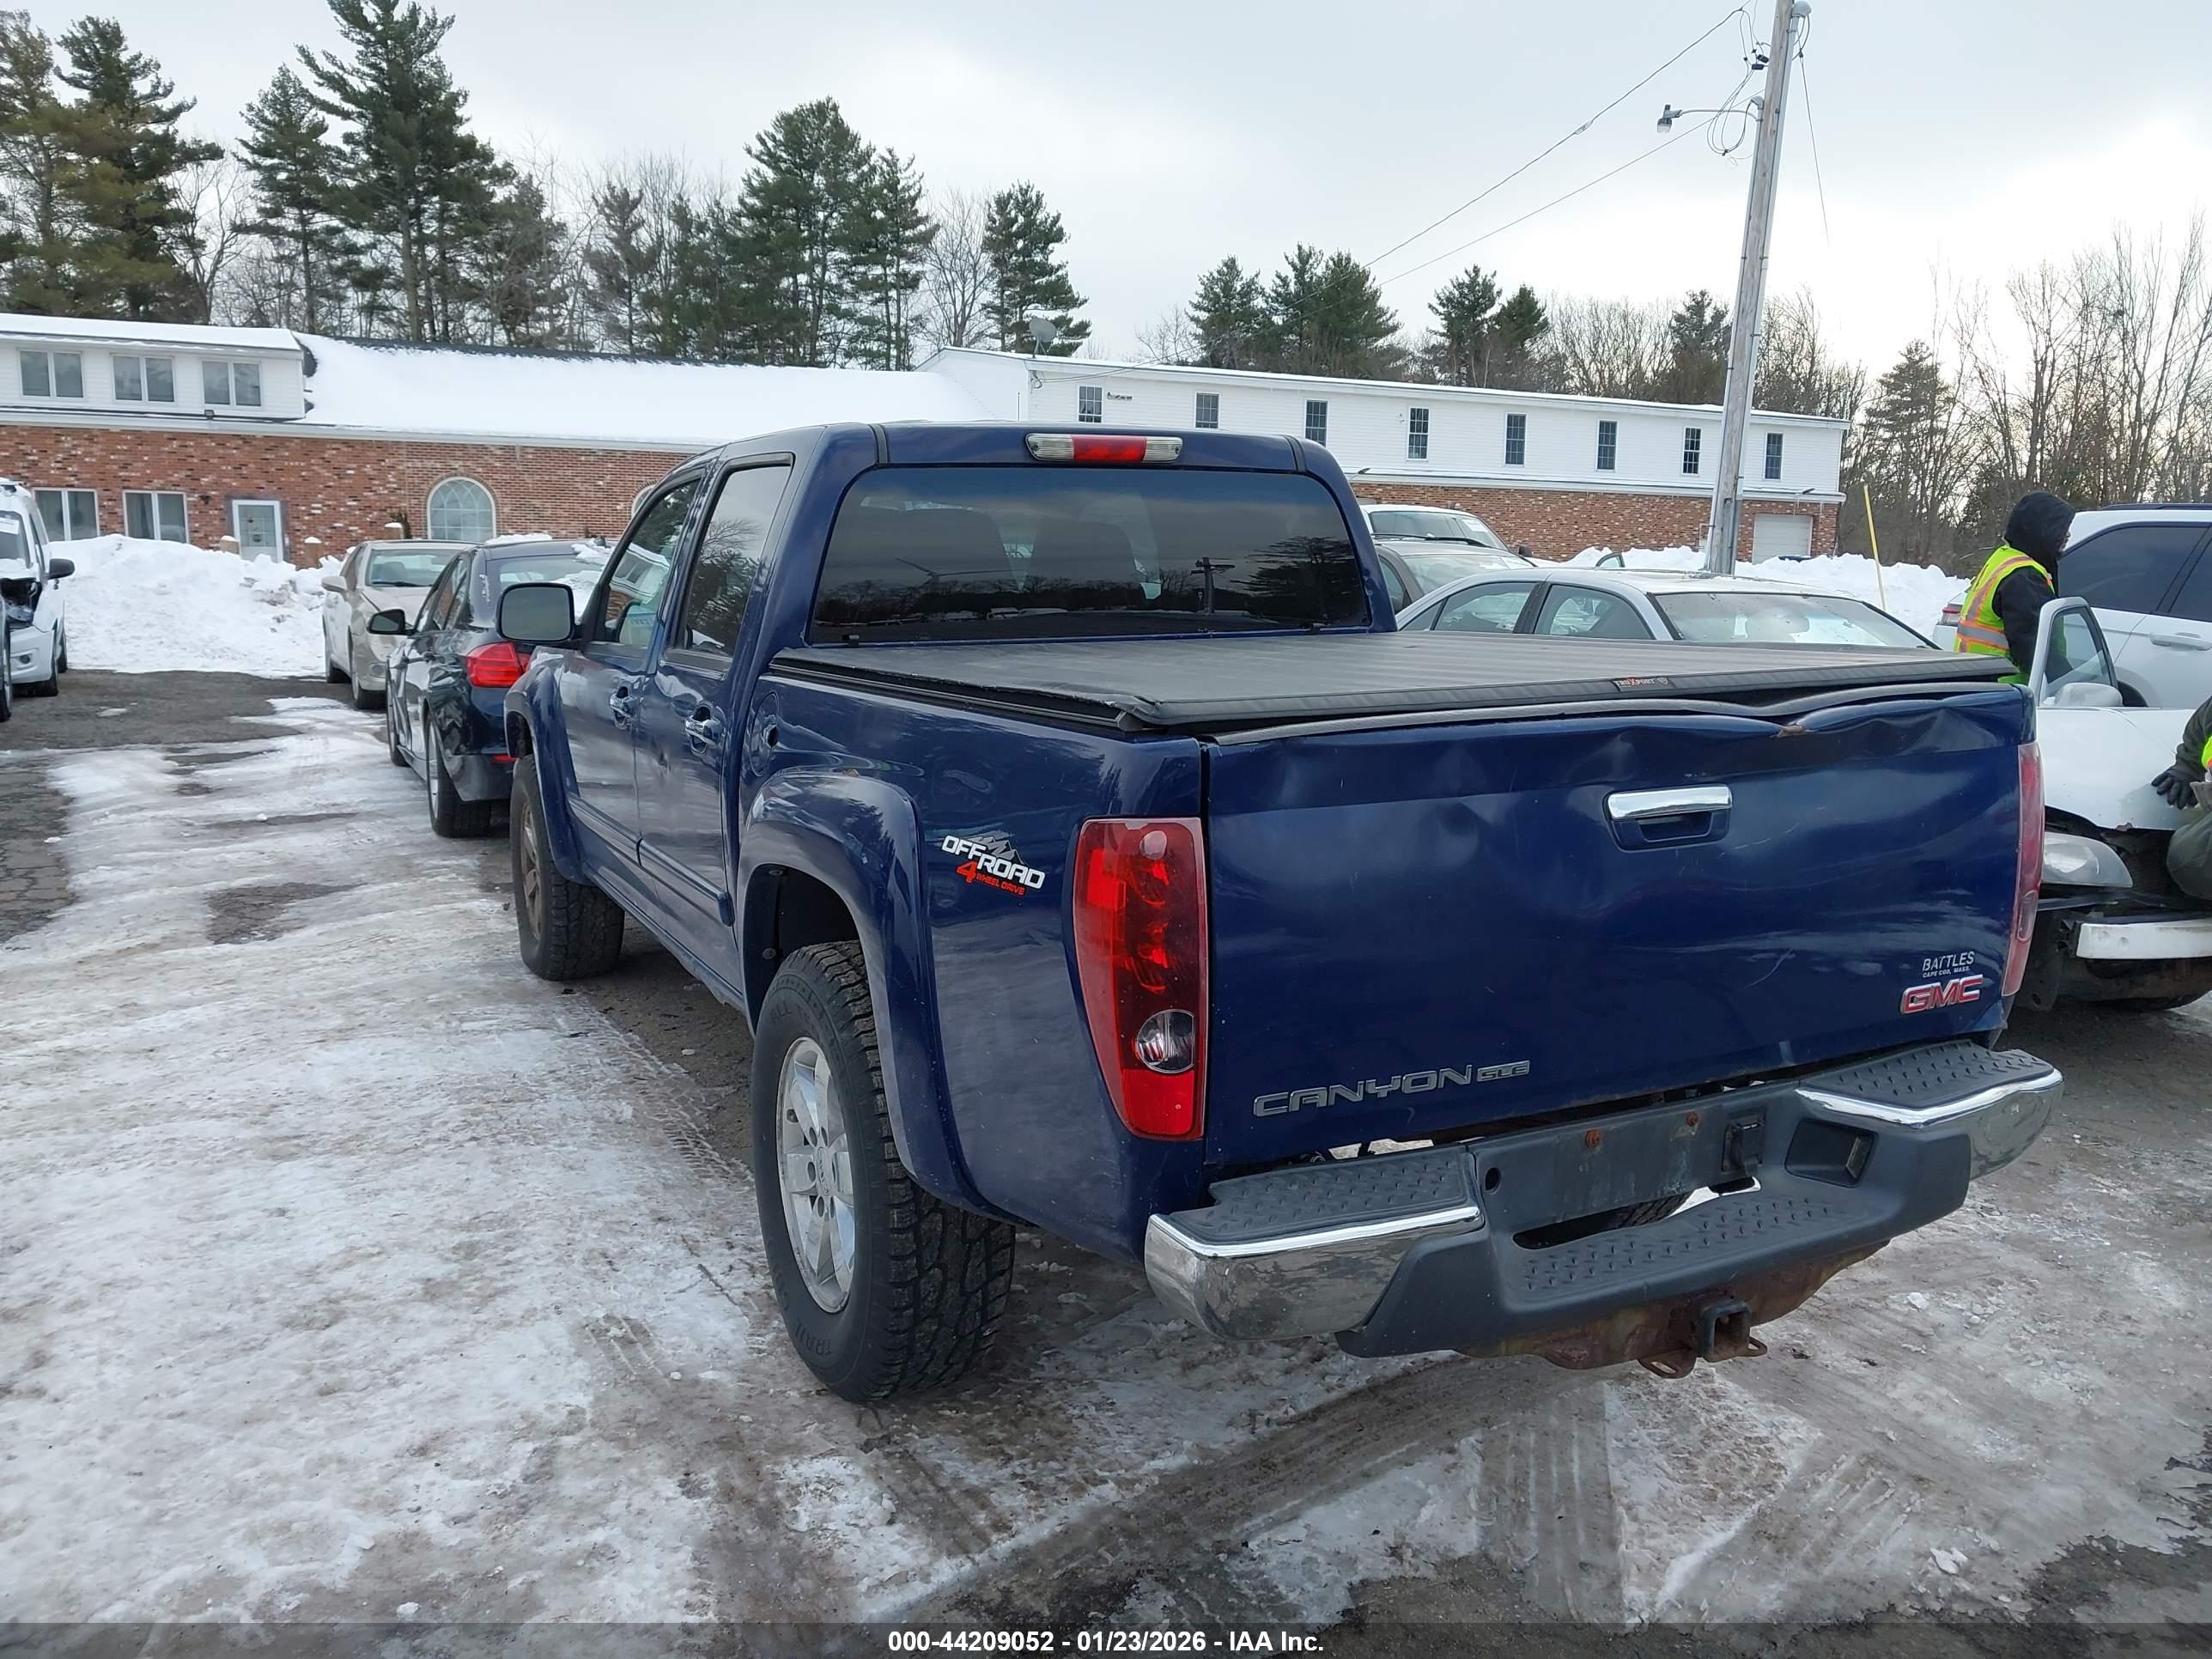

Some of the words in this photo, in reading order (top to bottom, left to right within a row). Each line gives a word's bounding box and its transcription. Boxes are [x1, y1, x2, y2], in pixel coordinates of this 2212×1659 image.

[956, 860, 977, 884] 4
[976, 872, 1000, 887] WHEEL
[1001, 881, 1026, 896] DRIVE
[1922, 951, 1976, 971] BATTLES
[1900, 974, 1984, 1015] GMC
[1253, 1064, 1473, 1117] CANYON
